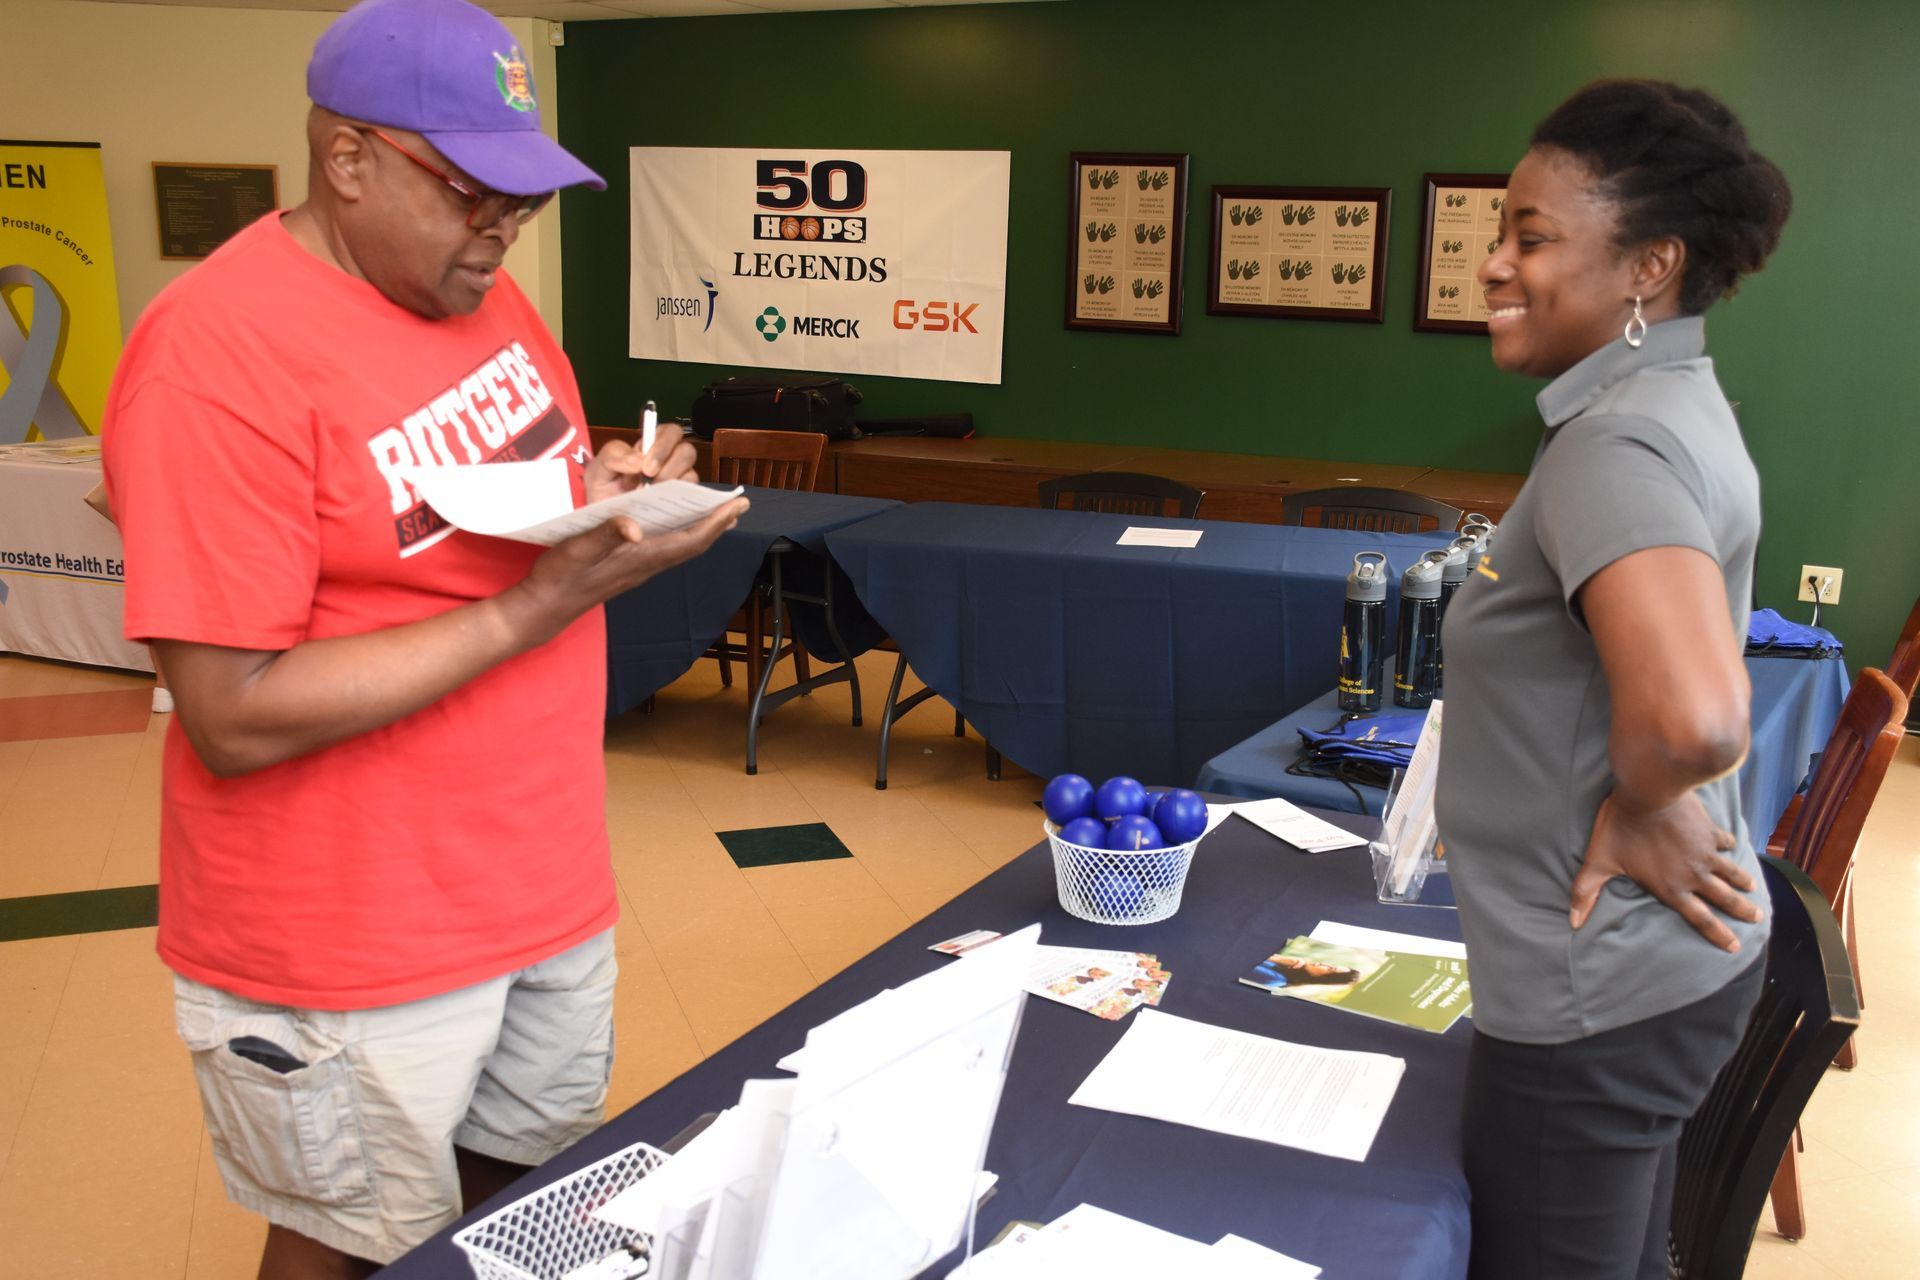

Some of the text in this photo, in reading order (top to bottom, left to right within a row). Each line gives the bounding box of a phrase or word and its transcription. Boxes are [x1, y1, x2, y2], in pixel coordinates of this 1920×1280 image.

[0, 164, 46, 189] EN
[757, 160, 867, 212] 50
[2, 217, 94, 267] Prostate Cancer
[732, 252, 887, 283] LEGENDS
[793, 316, 860, 339] MERCK
[893, 299, 981, 335] GSK
[368, 341, 553, 515] RUTGERS
[0, 551, 51, 568] rostate
[55, 553, 103, 574] Health
